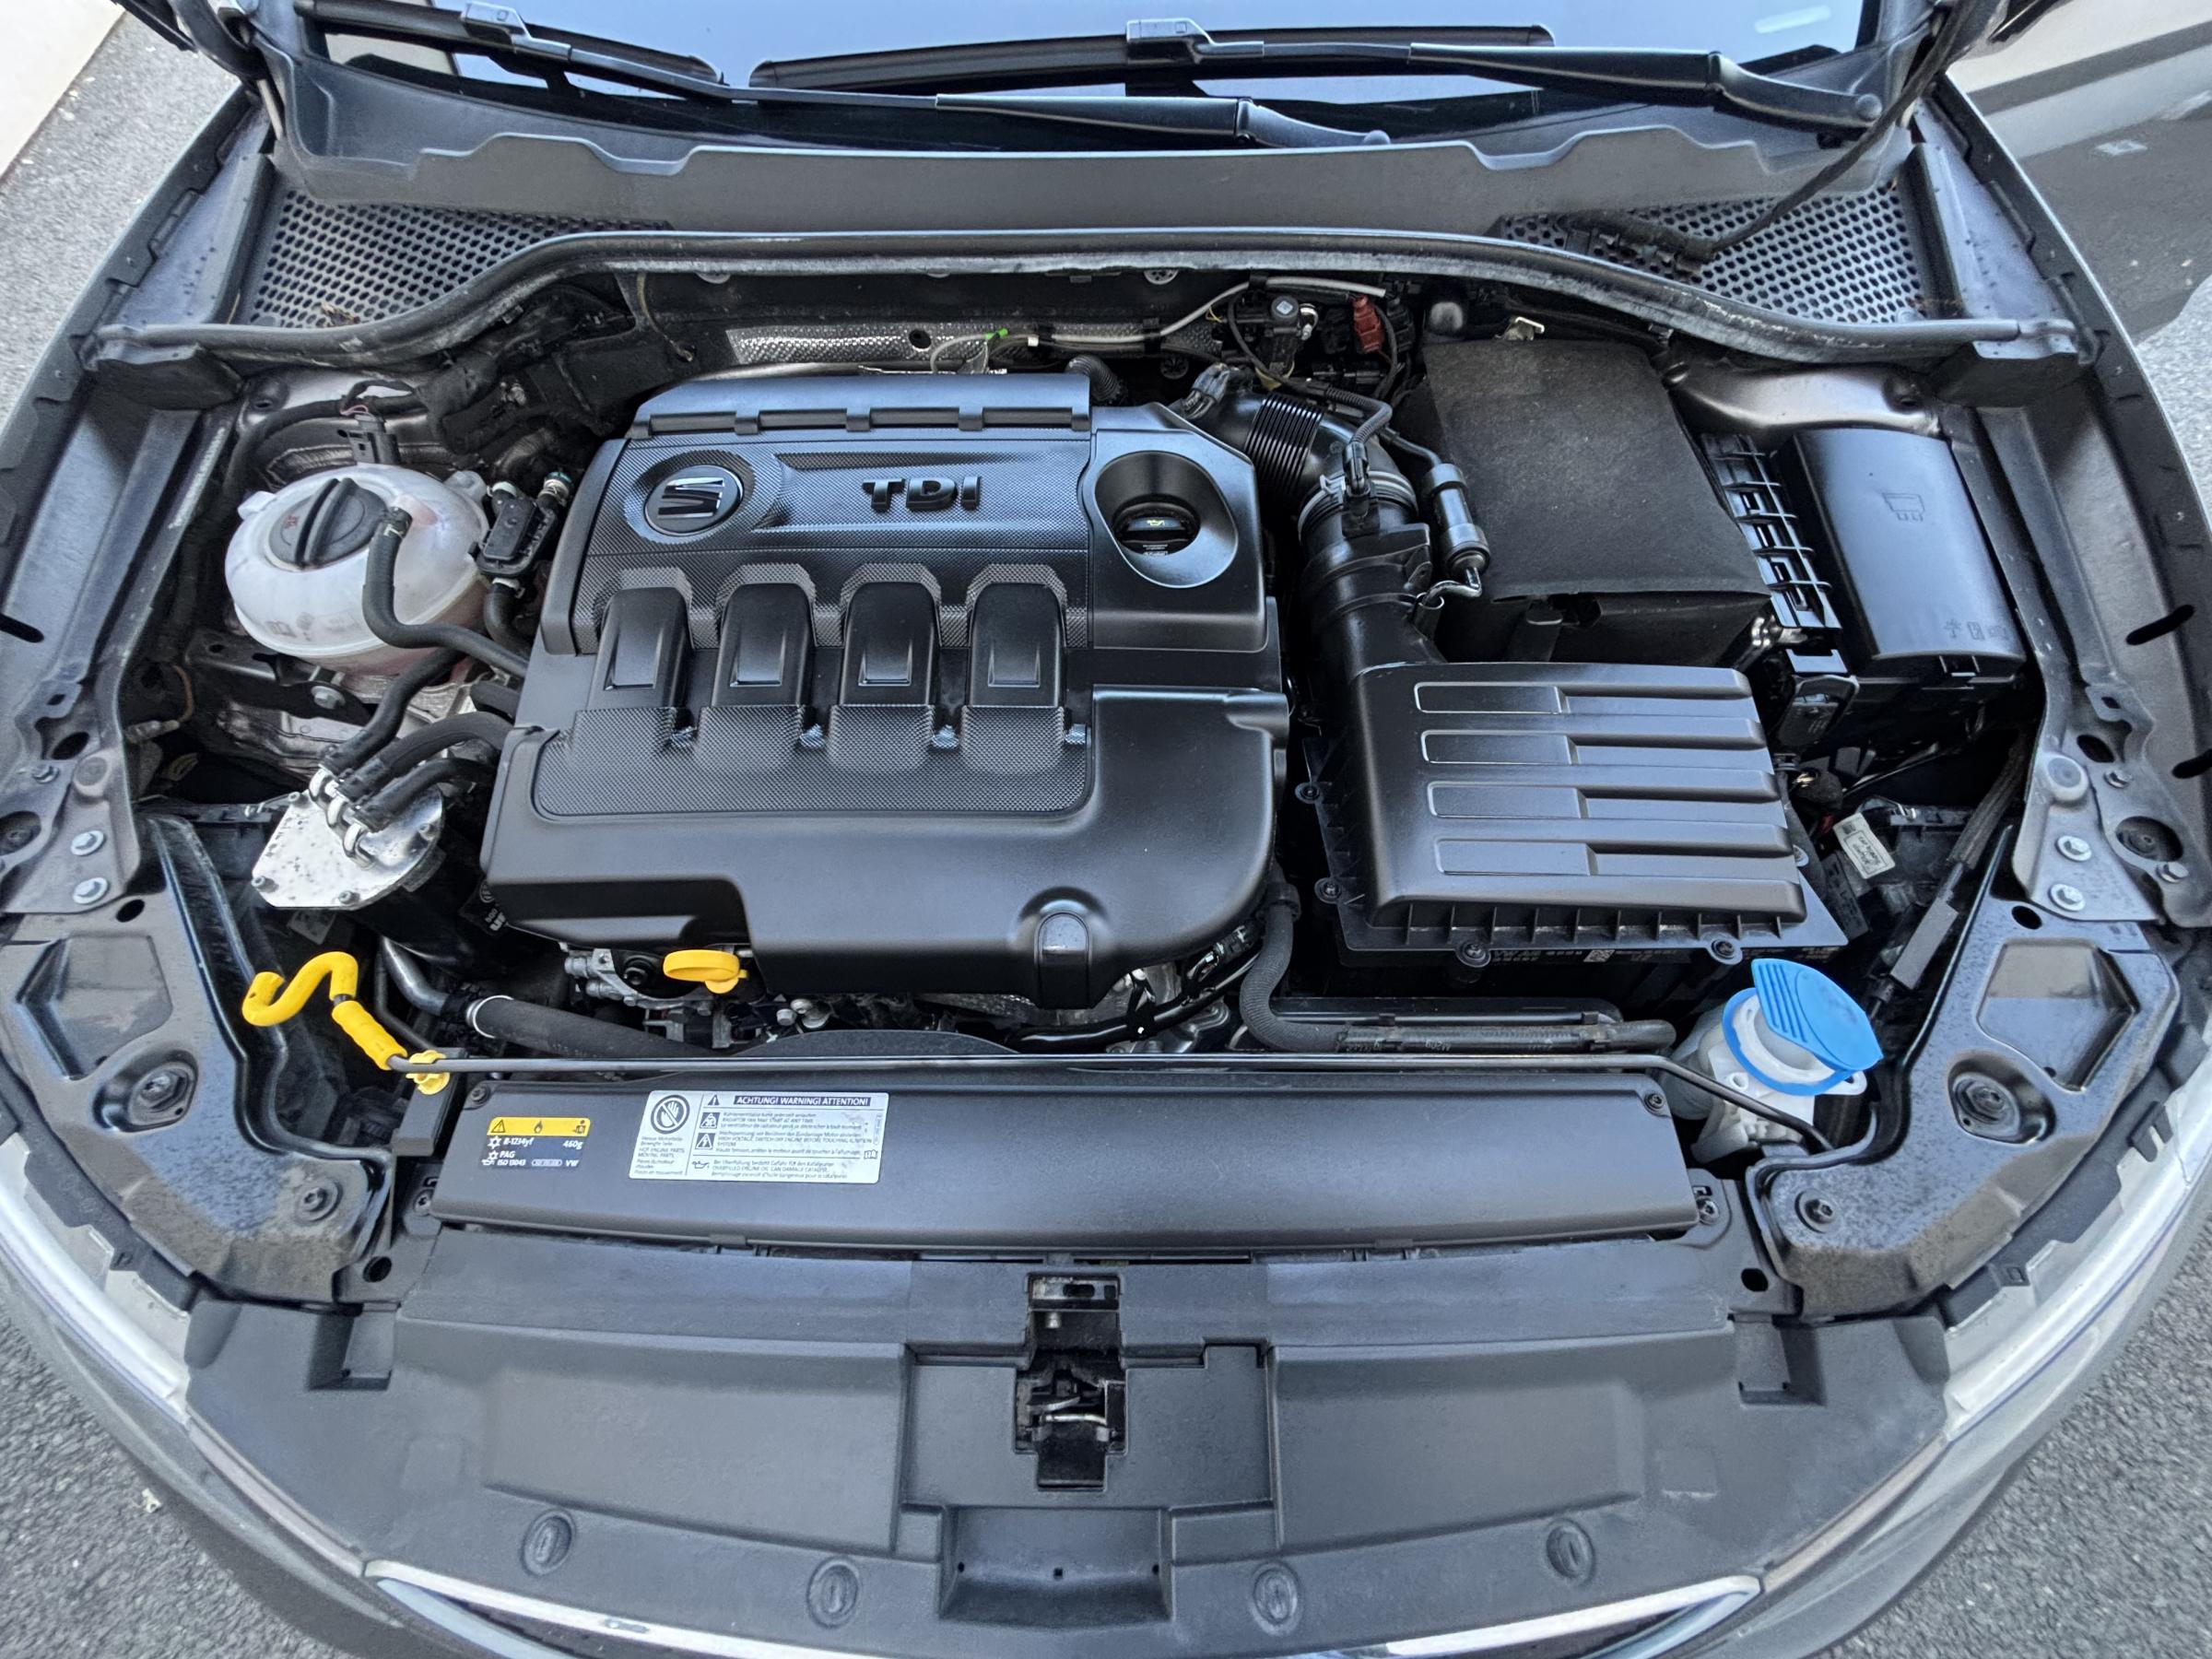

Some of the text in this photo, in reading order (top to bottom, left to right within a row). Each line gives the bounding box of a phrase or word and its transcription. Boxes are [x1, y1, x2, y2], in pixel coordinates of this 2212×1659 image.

[862, 476, 982, 512] TDI
[736, 1096, 868, 1106] ACHTUNG! WARNING! ATTENTION!
